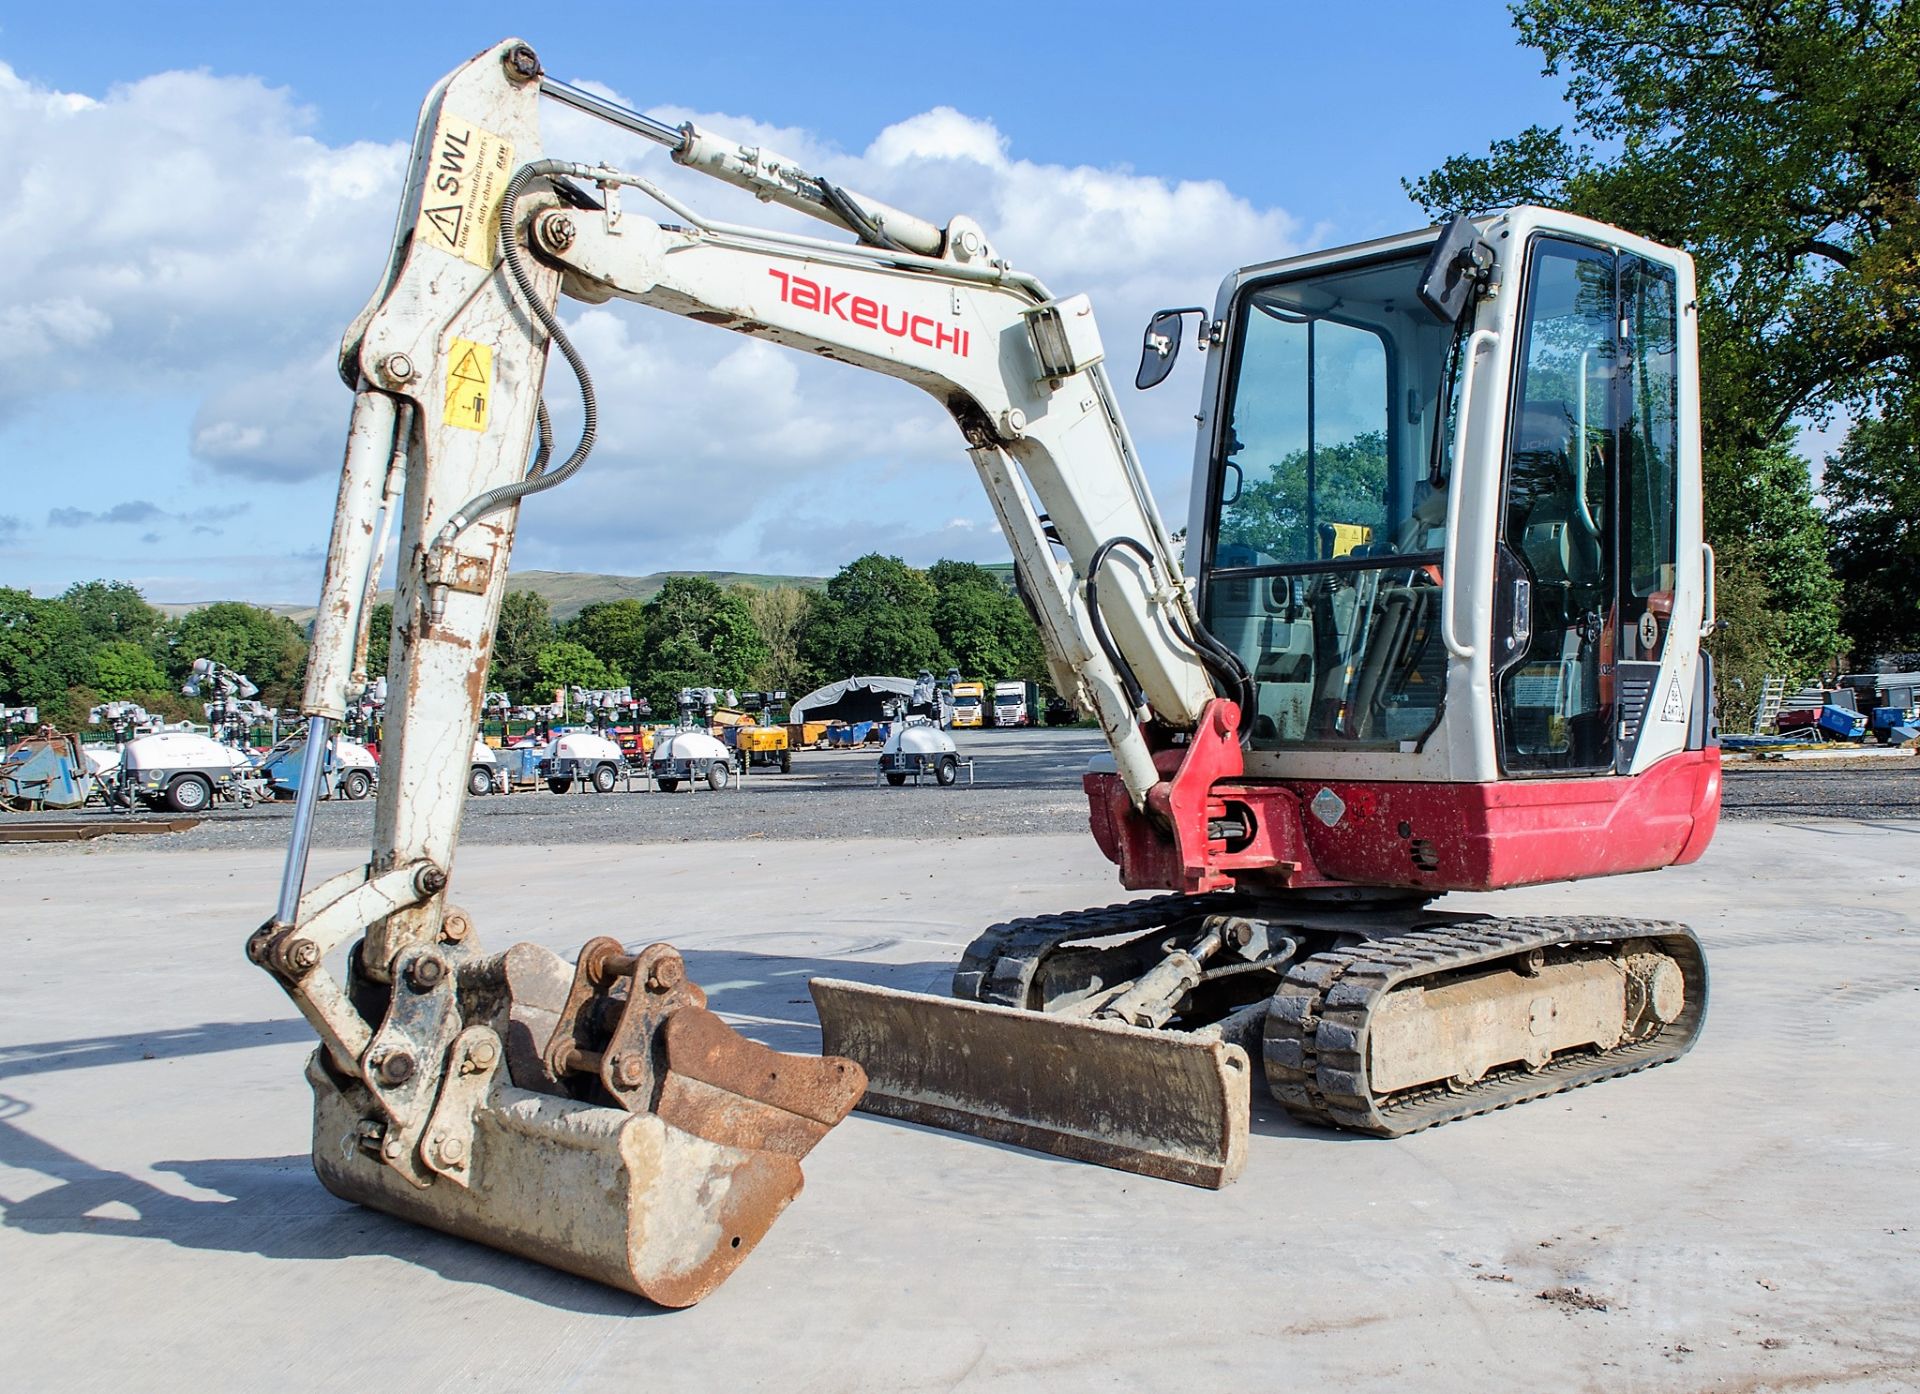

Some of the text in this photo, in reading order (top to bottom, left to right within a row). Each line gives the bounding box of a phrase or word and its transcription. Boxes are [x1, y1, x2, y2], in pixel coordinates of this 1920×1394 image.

[437, 130, 471, 196] SWL
[479, 171, 494, 224] duty charts
[458, 224, 470, 249] Refer
[467, 210, 473, 222] to
